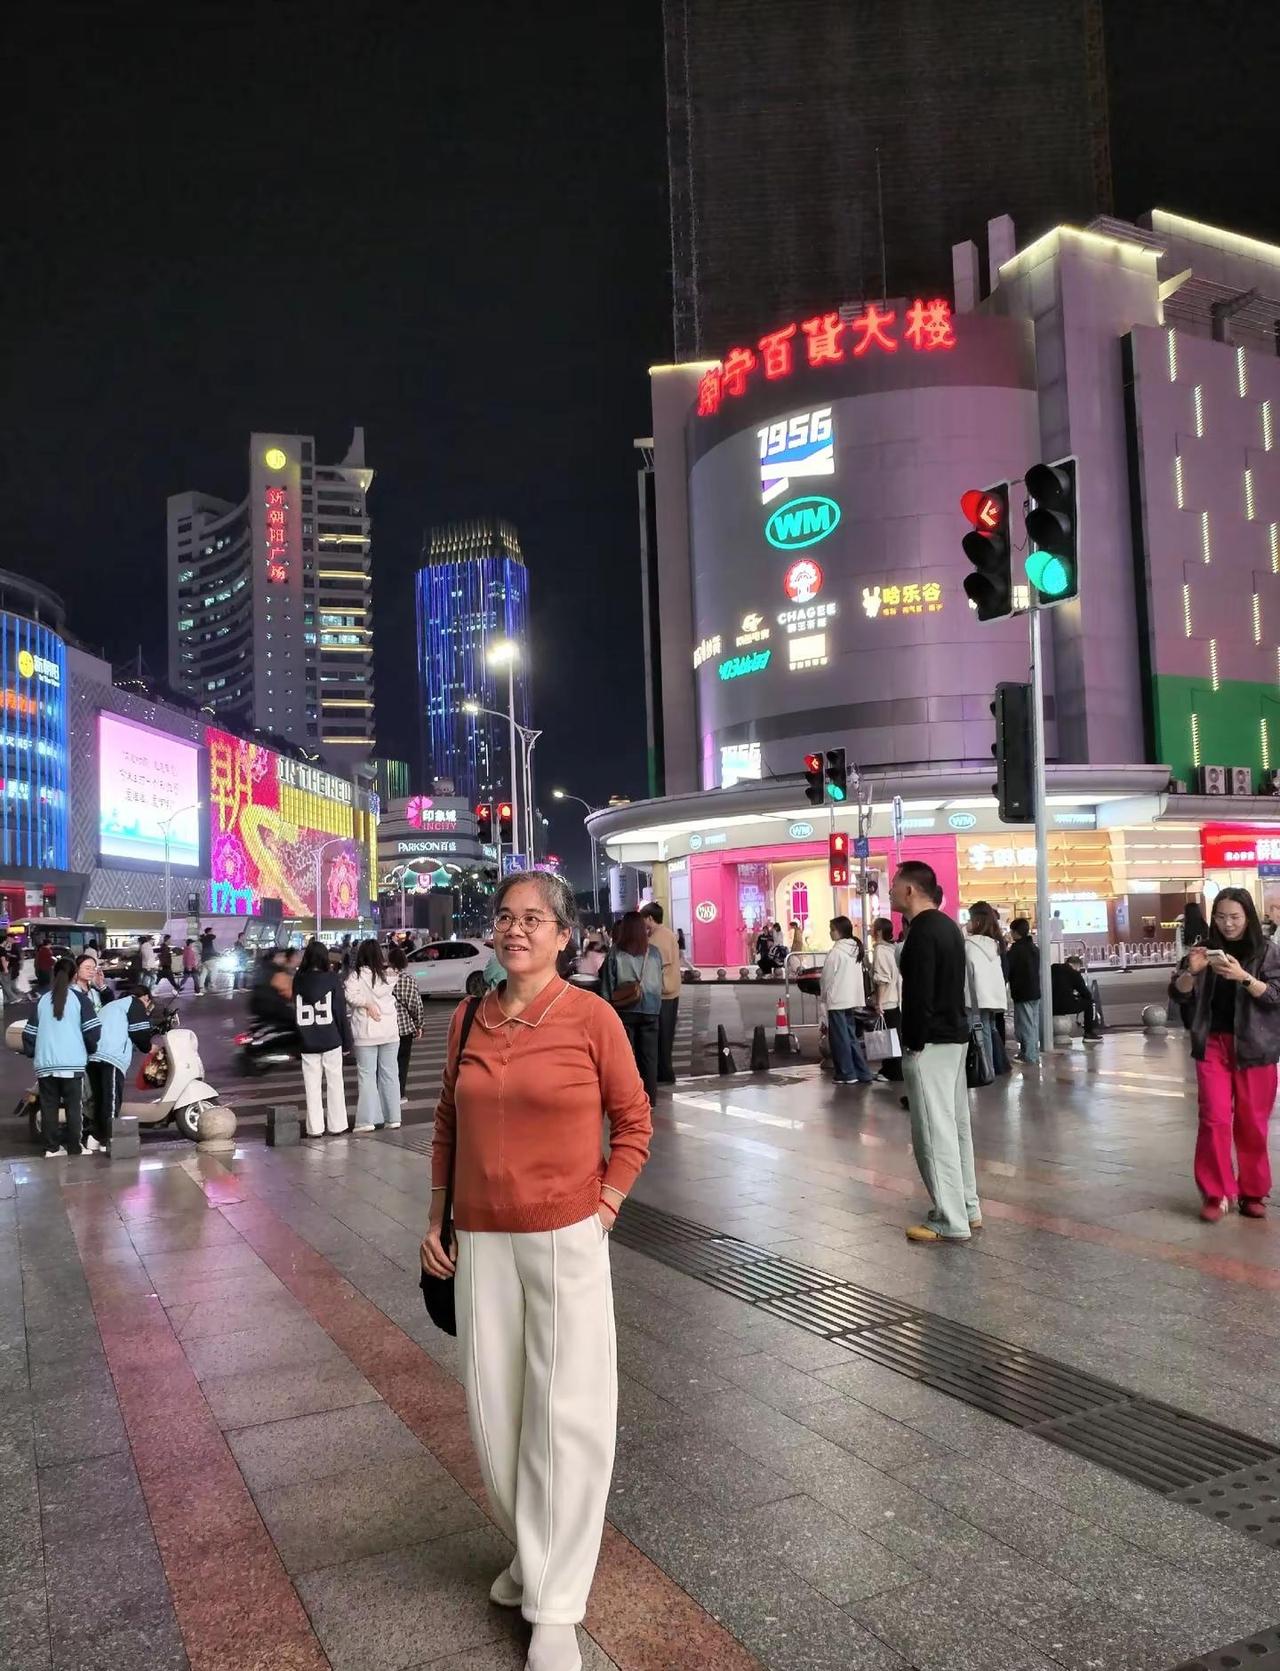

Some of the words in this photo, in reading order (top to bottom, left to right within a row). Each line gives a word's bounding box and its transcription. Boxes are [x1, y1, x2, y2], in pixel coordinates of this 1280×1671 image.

[757, 407, 833, 458] 1956
[775, 505, 830, 541] WM
[882, 582, 942, 605] 哈乐谷
[777, 602, 837, 626] CHAGEE
[423, 822, 457, 831] INCITY
[833, 870, 846, 882] 51
